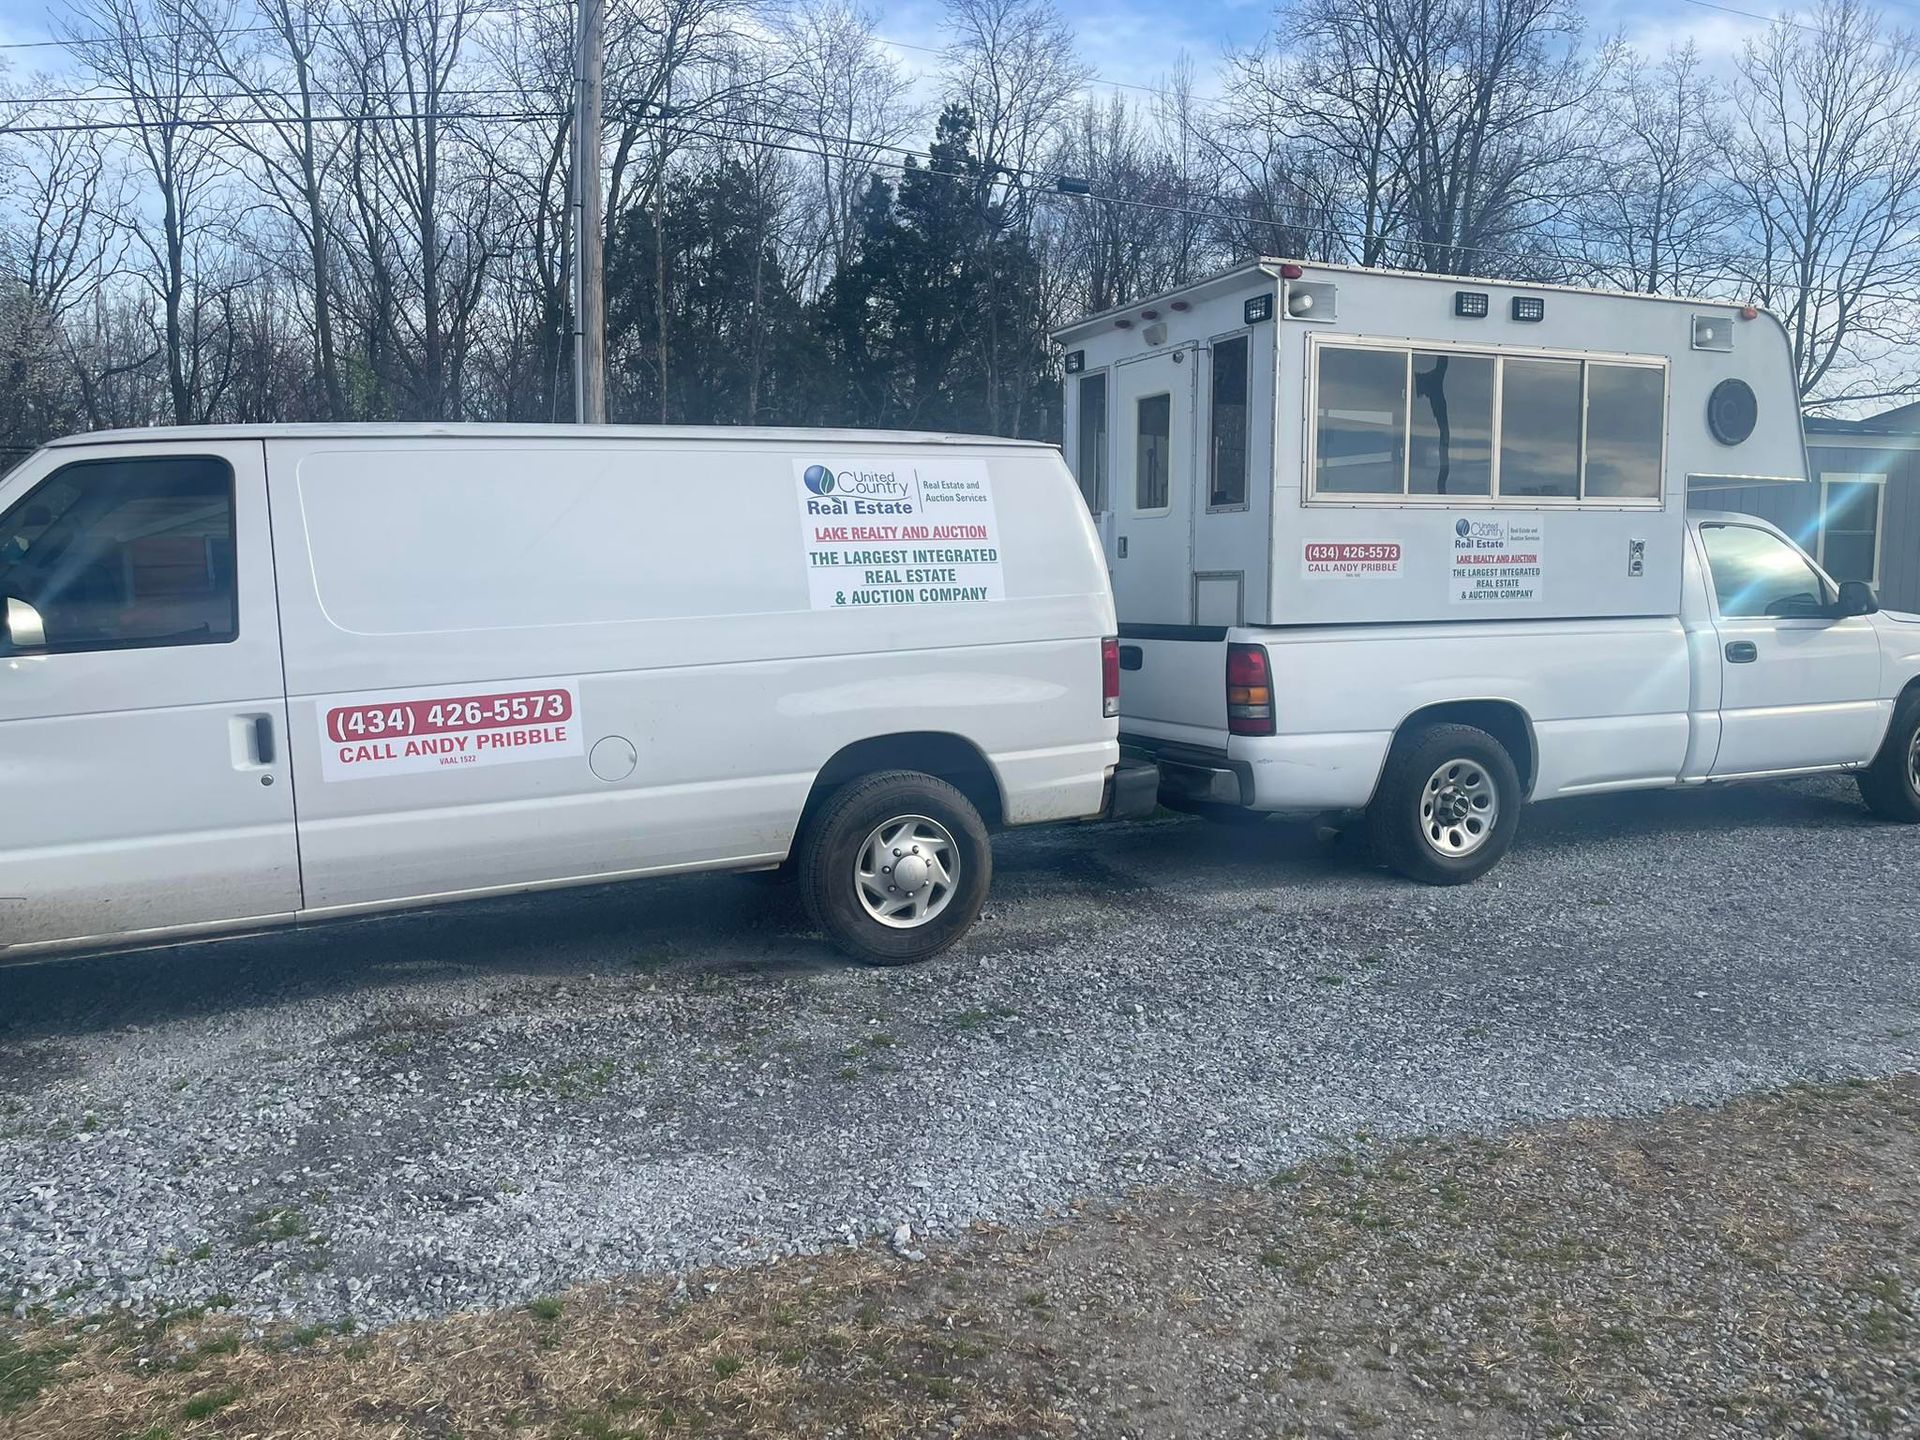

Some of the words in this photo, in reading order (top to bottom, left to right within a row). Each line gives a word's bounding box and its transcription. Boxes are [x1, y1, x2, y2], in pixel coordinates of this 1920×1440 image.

[854, 472, 895, 483] United
[837, 472, 908, 496] Country
[924, 481, 939, 489] Real
[942, 481, 964, 489] Estate
[967, 481, 979, 489] and
[926, 493, 954, 502] Auction
[956, 493, 987, 502] Services
[807, 501, 848, 515] Real
[855, 501, 913, 514] Estate
[815, 527, 848, 540] LAKE
[852, 526, 898, 539] REALTY
[902, 526, 929, 538] AND
[933, 525, 987, 538] AUCTION
[1471, 522, 1504, 537] Country
[1455, 540, 1473, 548] Real
[1477, 540, 1503, 548] Estate
[809, 552, 839, 565] THE
[844, 550, 908, 564] LARGEST
[913, 549, 997, 563] INTEGRATED
[1309, 546, 1338, 560] (434)
[1343, 547, 1397, 558] 426-5573
[1457, 555, 1472, 563] LAKE
[1474, 555, 1495, 563] REALTY
[1497, 555, 1510, 563] AND
[1511, 554, 1537, 563] AUCTION
[1361, 563, 1397, 571] PRIBBLE
[1500, 568, 1540, 576] INTEGRATED
[865, 570, 901, 584] REAL
[907, 569, 956, 582] ESTATE
[1496, 579, 1519, 587] ESTATE
[835, 591, 846, 604] &
[852, 589, 914, 604] AUCTION
[919, 587, 987, 602] COMPANY
[1461, 591, 1466, 599] &
[1500, 590, 1533, 598] COMPANY
[337, 706, 416, 740] (434)
[427, 695, 564, 727] 426-5573
[339, 744, 397, 763] CALL
[405, 736, 469, 757] ANDY
[477, 727, 567, 749] PRIBBLE
[439, 757, 459, 765] VAAL
[460, 755, 476, 764] 1522
